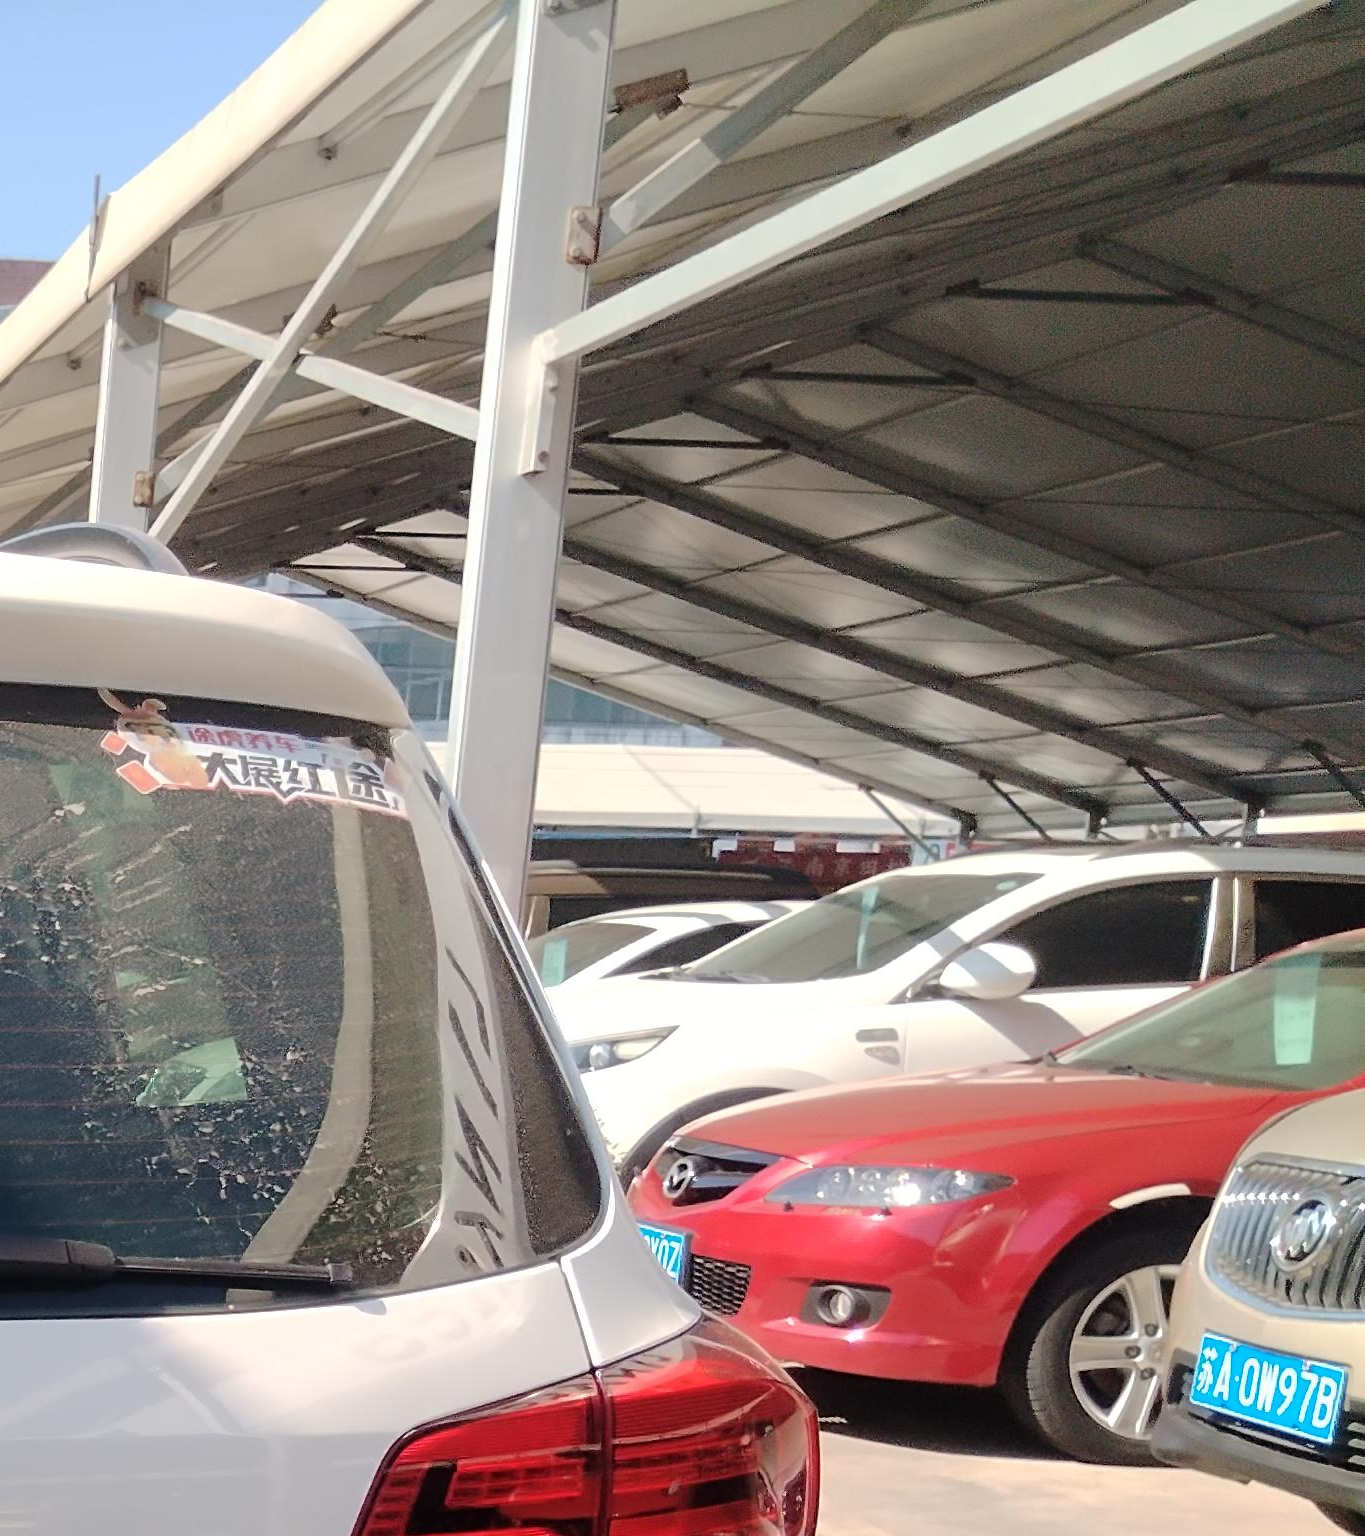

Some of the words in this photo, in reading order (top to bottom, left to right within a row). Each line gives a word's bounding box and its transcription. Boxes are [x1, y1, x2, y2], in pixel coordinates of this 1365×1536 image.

[187, 726, 302, 754] 途虎养车
[1196, 1346, 1338, 1429] 苏A·0W97B
